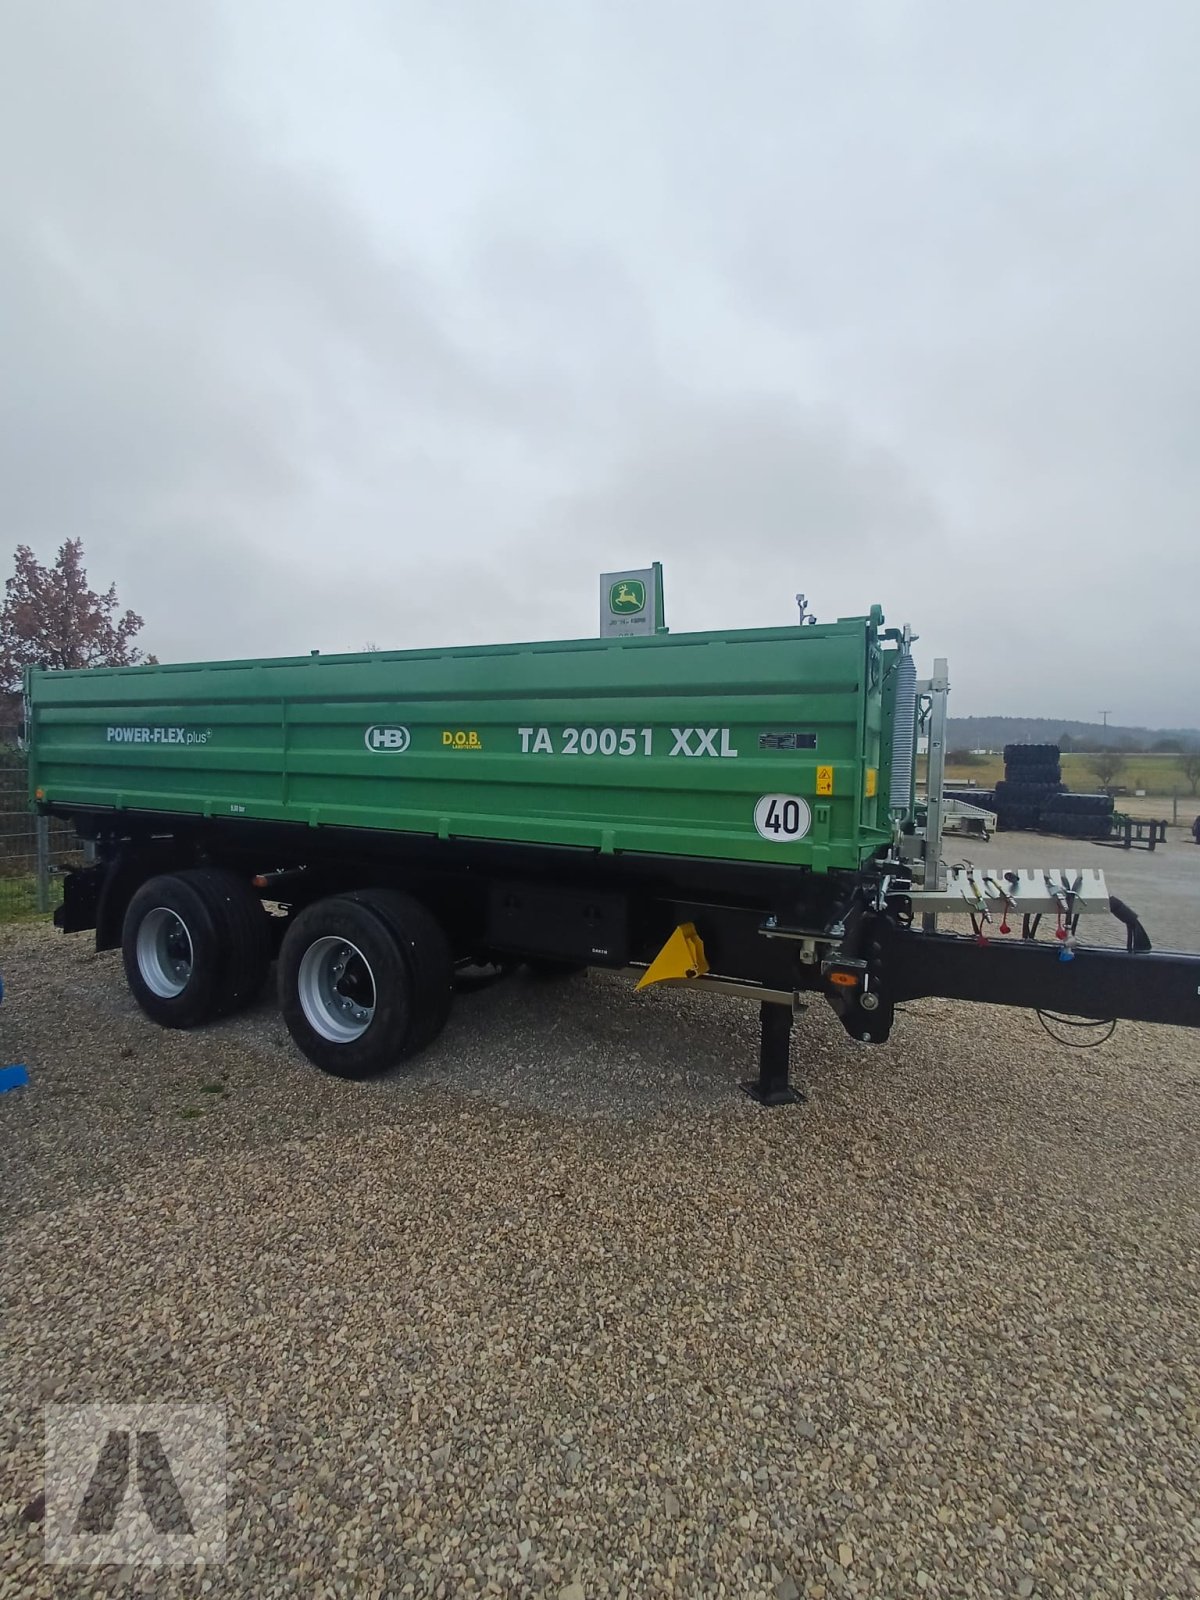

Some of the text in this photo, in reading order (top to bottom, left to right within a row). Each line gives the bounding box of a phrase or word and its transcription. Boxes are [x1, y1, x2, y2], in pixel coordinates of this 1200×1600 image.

[107, 728, 185, 743] POWER-FLEX
[373, 729, 404, 748] HB
[442, 731, 481, 745] D.O.B.
[518, 728, 554, 753] TA
[561, 728, 653, 756] 20051
[668, 728, 738, 757] XXL
[764, 799, 801, 835] 40
